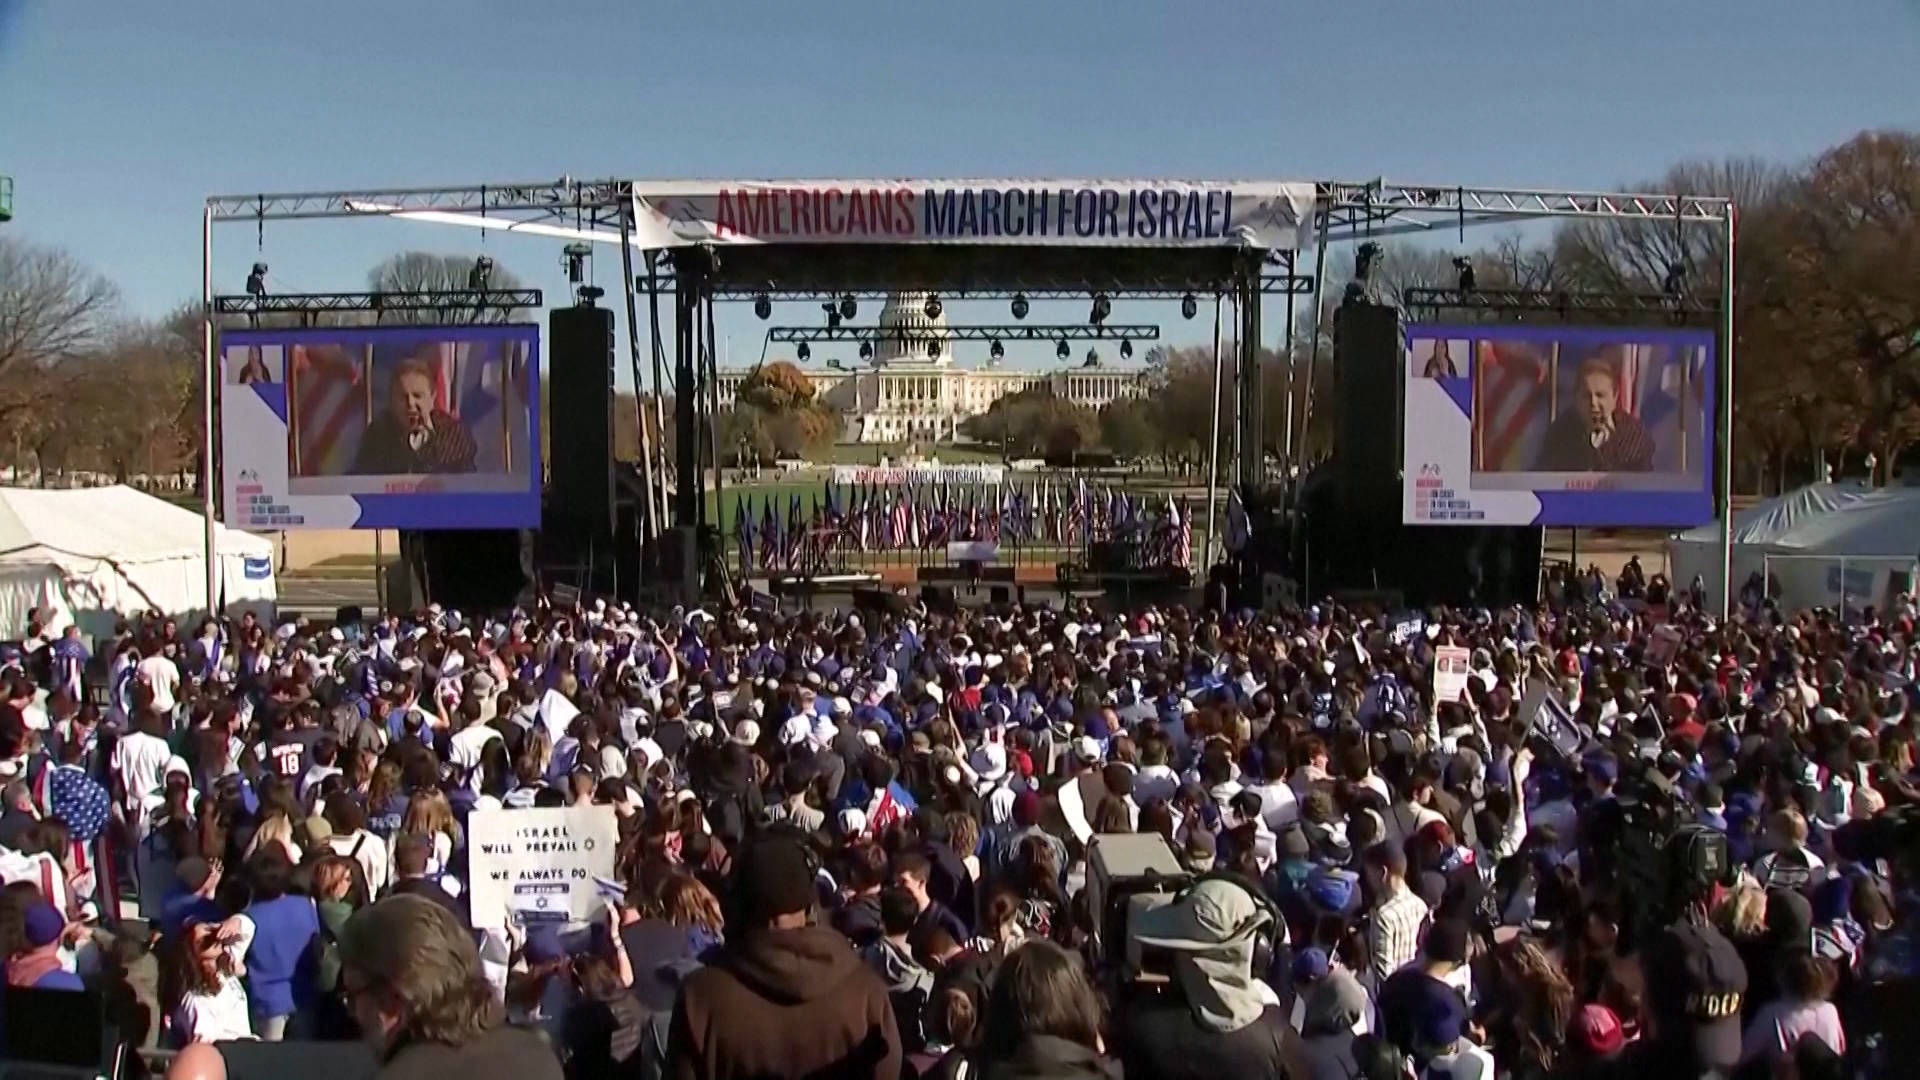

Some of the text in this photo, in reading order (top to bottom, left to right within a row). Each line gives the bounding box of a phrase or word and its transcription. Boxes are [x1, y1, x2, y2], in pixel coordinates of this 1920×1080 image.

[716, 187, 1237, 238] AMERICANS MARCH FOR ISRAEL
[516, 825, 569, 838] ISRAEL
[526, 841, 577, 852] PREVAIL
[490, 868, 586, 880] WE ALWAYS DO
